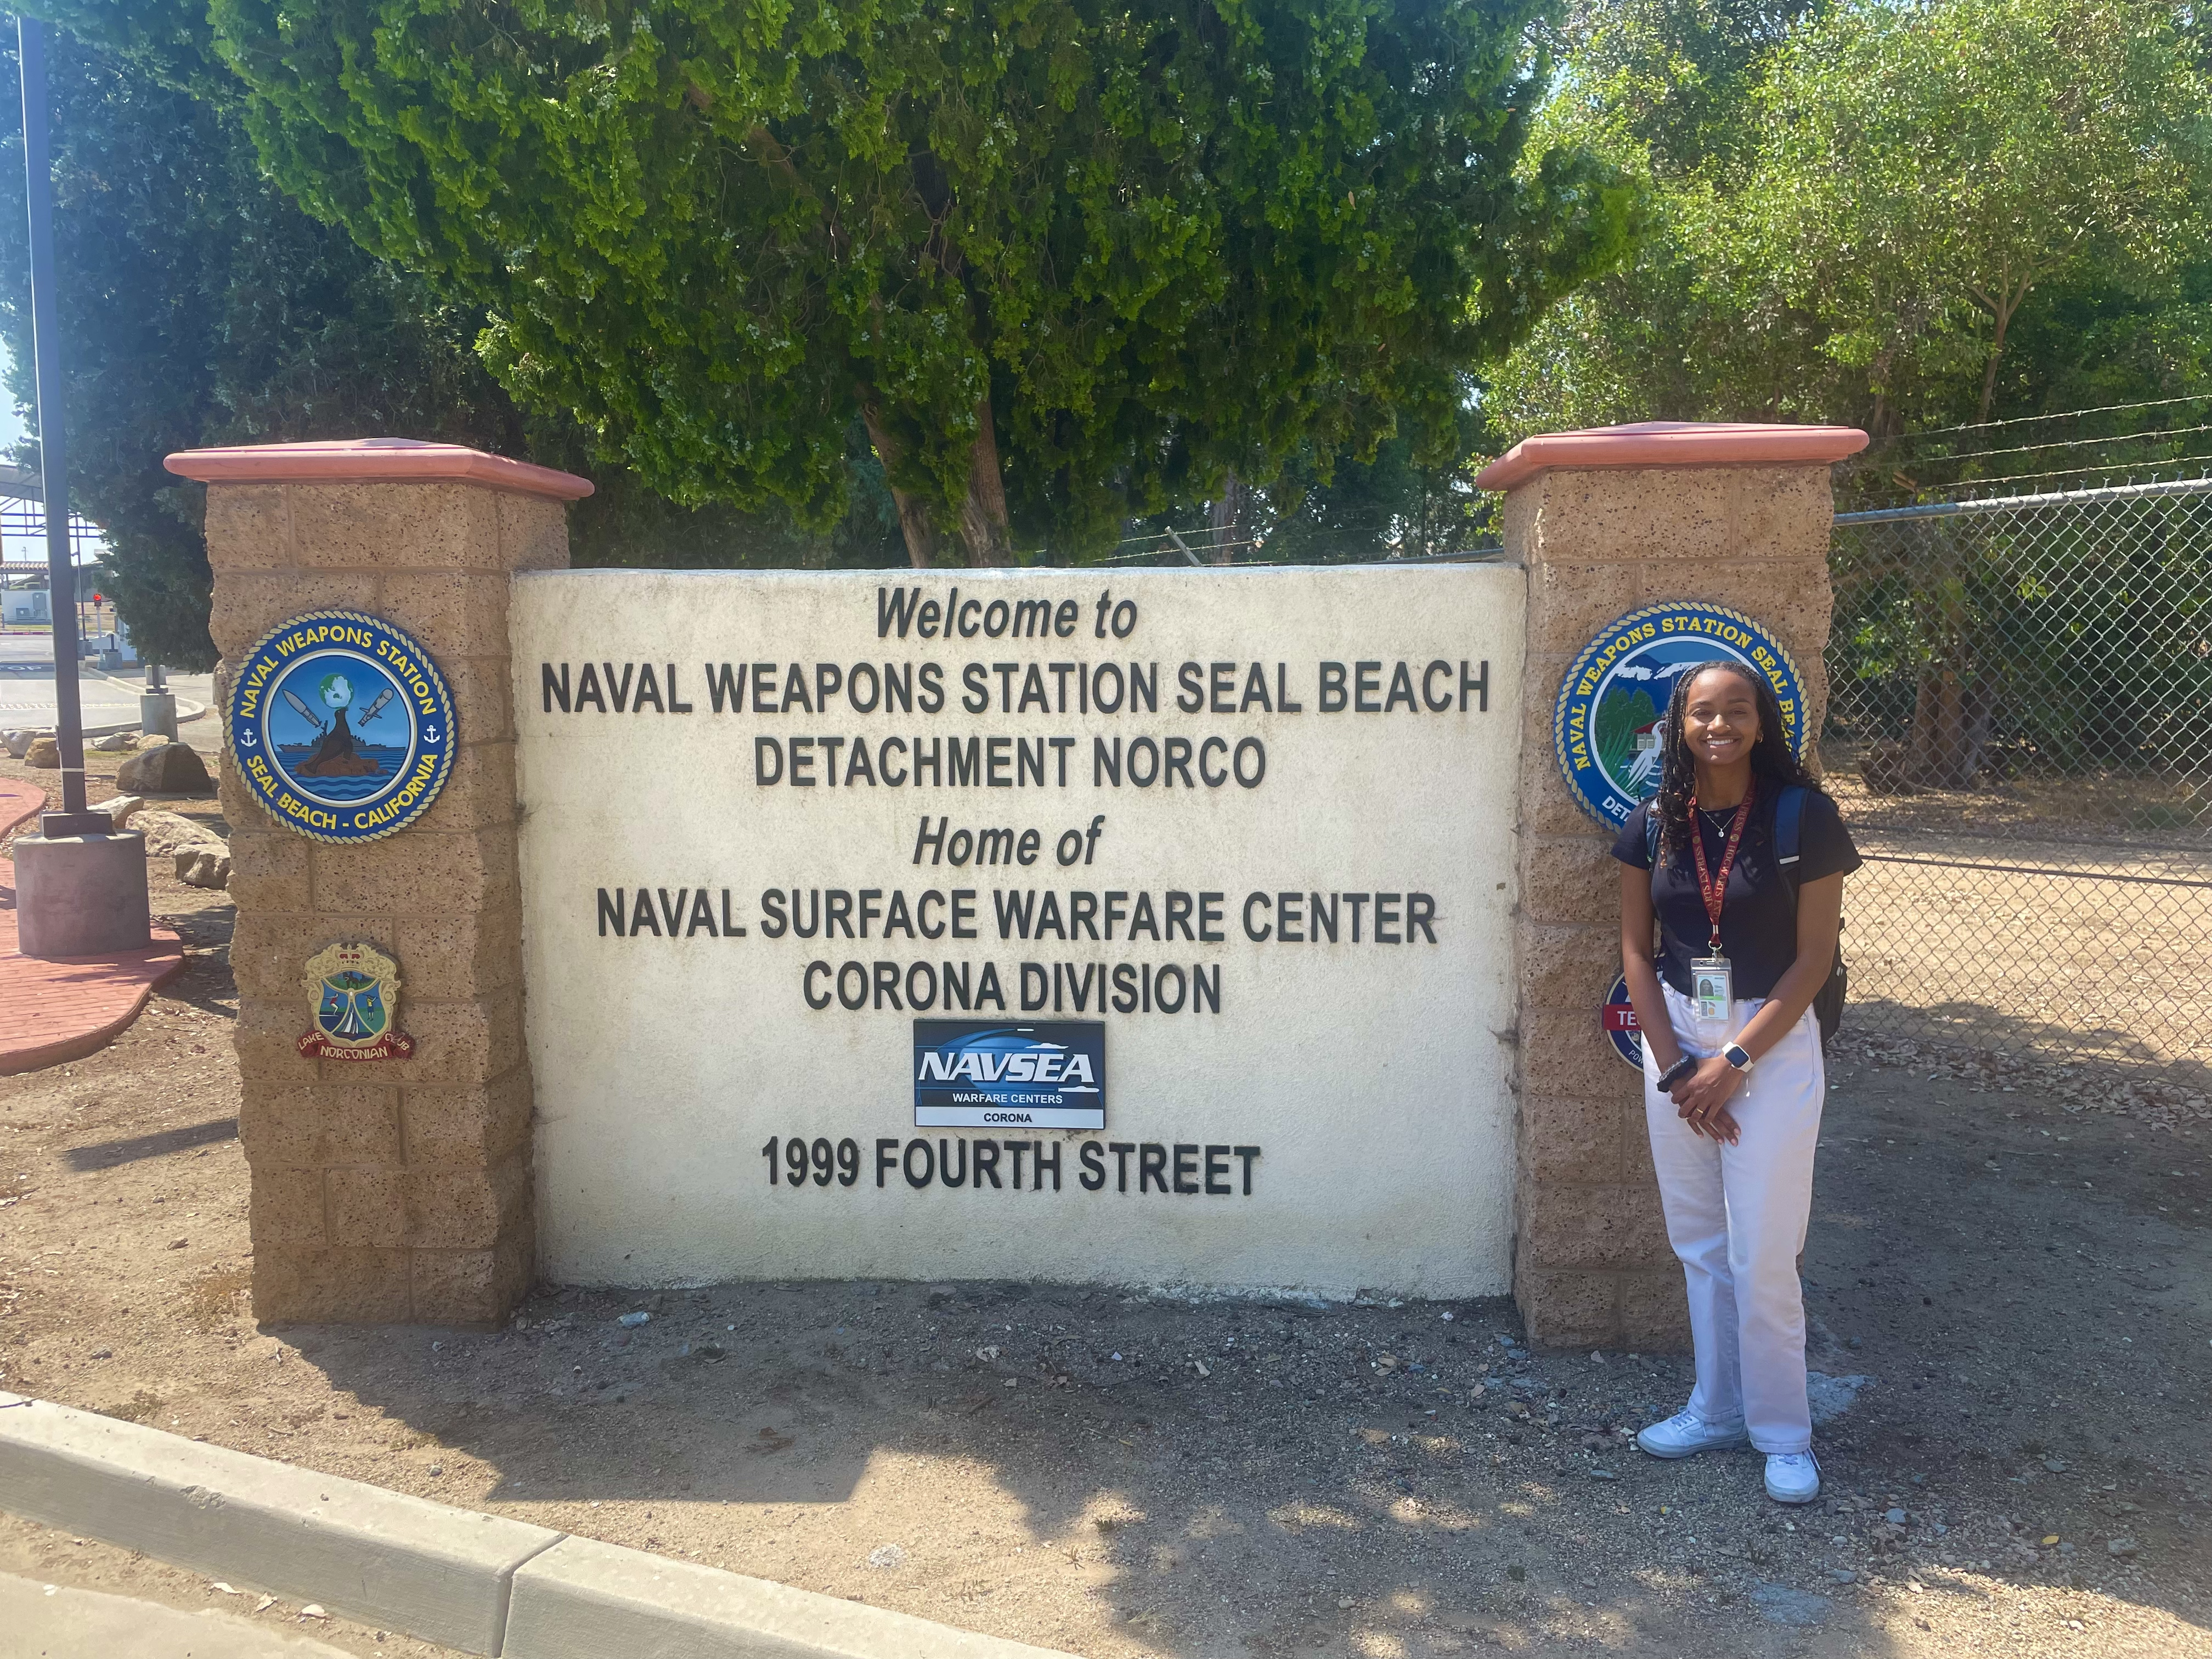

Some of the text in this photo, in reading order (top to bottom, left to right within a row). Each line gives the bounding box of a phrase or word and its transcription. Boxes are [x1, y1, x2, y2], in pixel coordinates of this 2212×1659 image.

[878, 588, 1138, 639] Welcome to
[1662, 616, 1753, 648] STATION
[240, 625, 437, 718] NAVAL WEAPONS STATION
[1577, 623, 1656, 696] WEAPONS
[1751, 646, 1789, 695] SEAL
[542, 660, 1489, 714] NAVAL WEAPONS STATION SEAL BEACH
[755, 736, 1266, 788] DETACHMENT NORCO
[1570, 703, 1591, 770] NAVAL
[247, 755, 280, 799] SEAL
[276, 793, 337, 830] BEACH
[353, 753, 438, 829] CALIFORNIA
[912, 815, 1105, 867] Home of
[1715, 845, 1736, 897] HOGWARTS
[597, 888, 1437, 944] NAVAL SURFACE WARFARE CENTER
[1713, 900, 1722, 919] EXP
[803, 960, 1221, 1014] CORONA DIVISION
[1617, 1011, 1640, 1026] TE
[298, 1032, 325, 1051] LAKE
[320, 1045, 388, 1059] NORCONIAN
[918, 1052, 1094, 1083] NAVSEA
[952, 1093, 1063, 1104] WARFARE CENTERS
[984, 1113, 1032, 1122] CORONA
[762, 1136, 1261, 1195] 1999 FOURTH STREET
